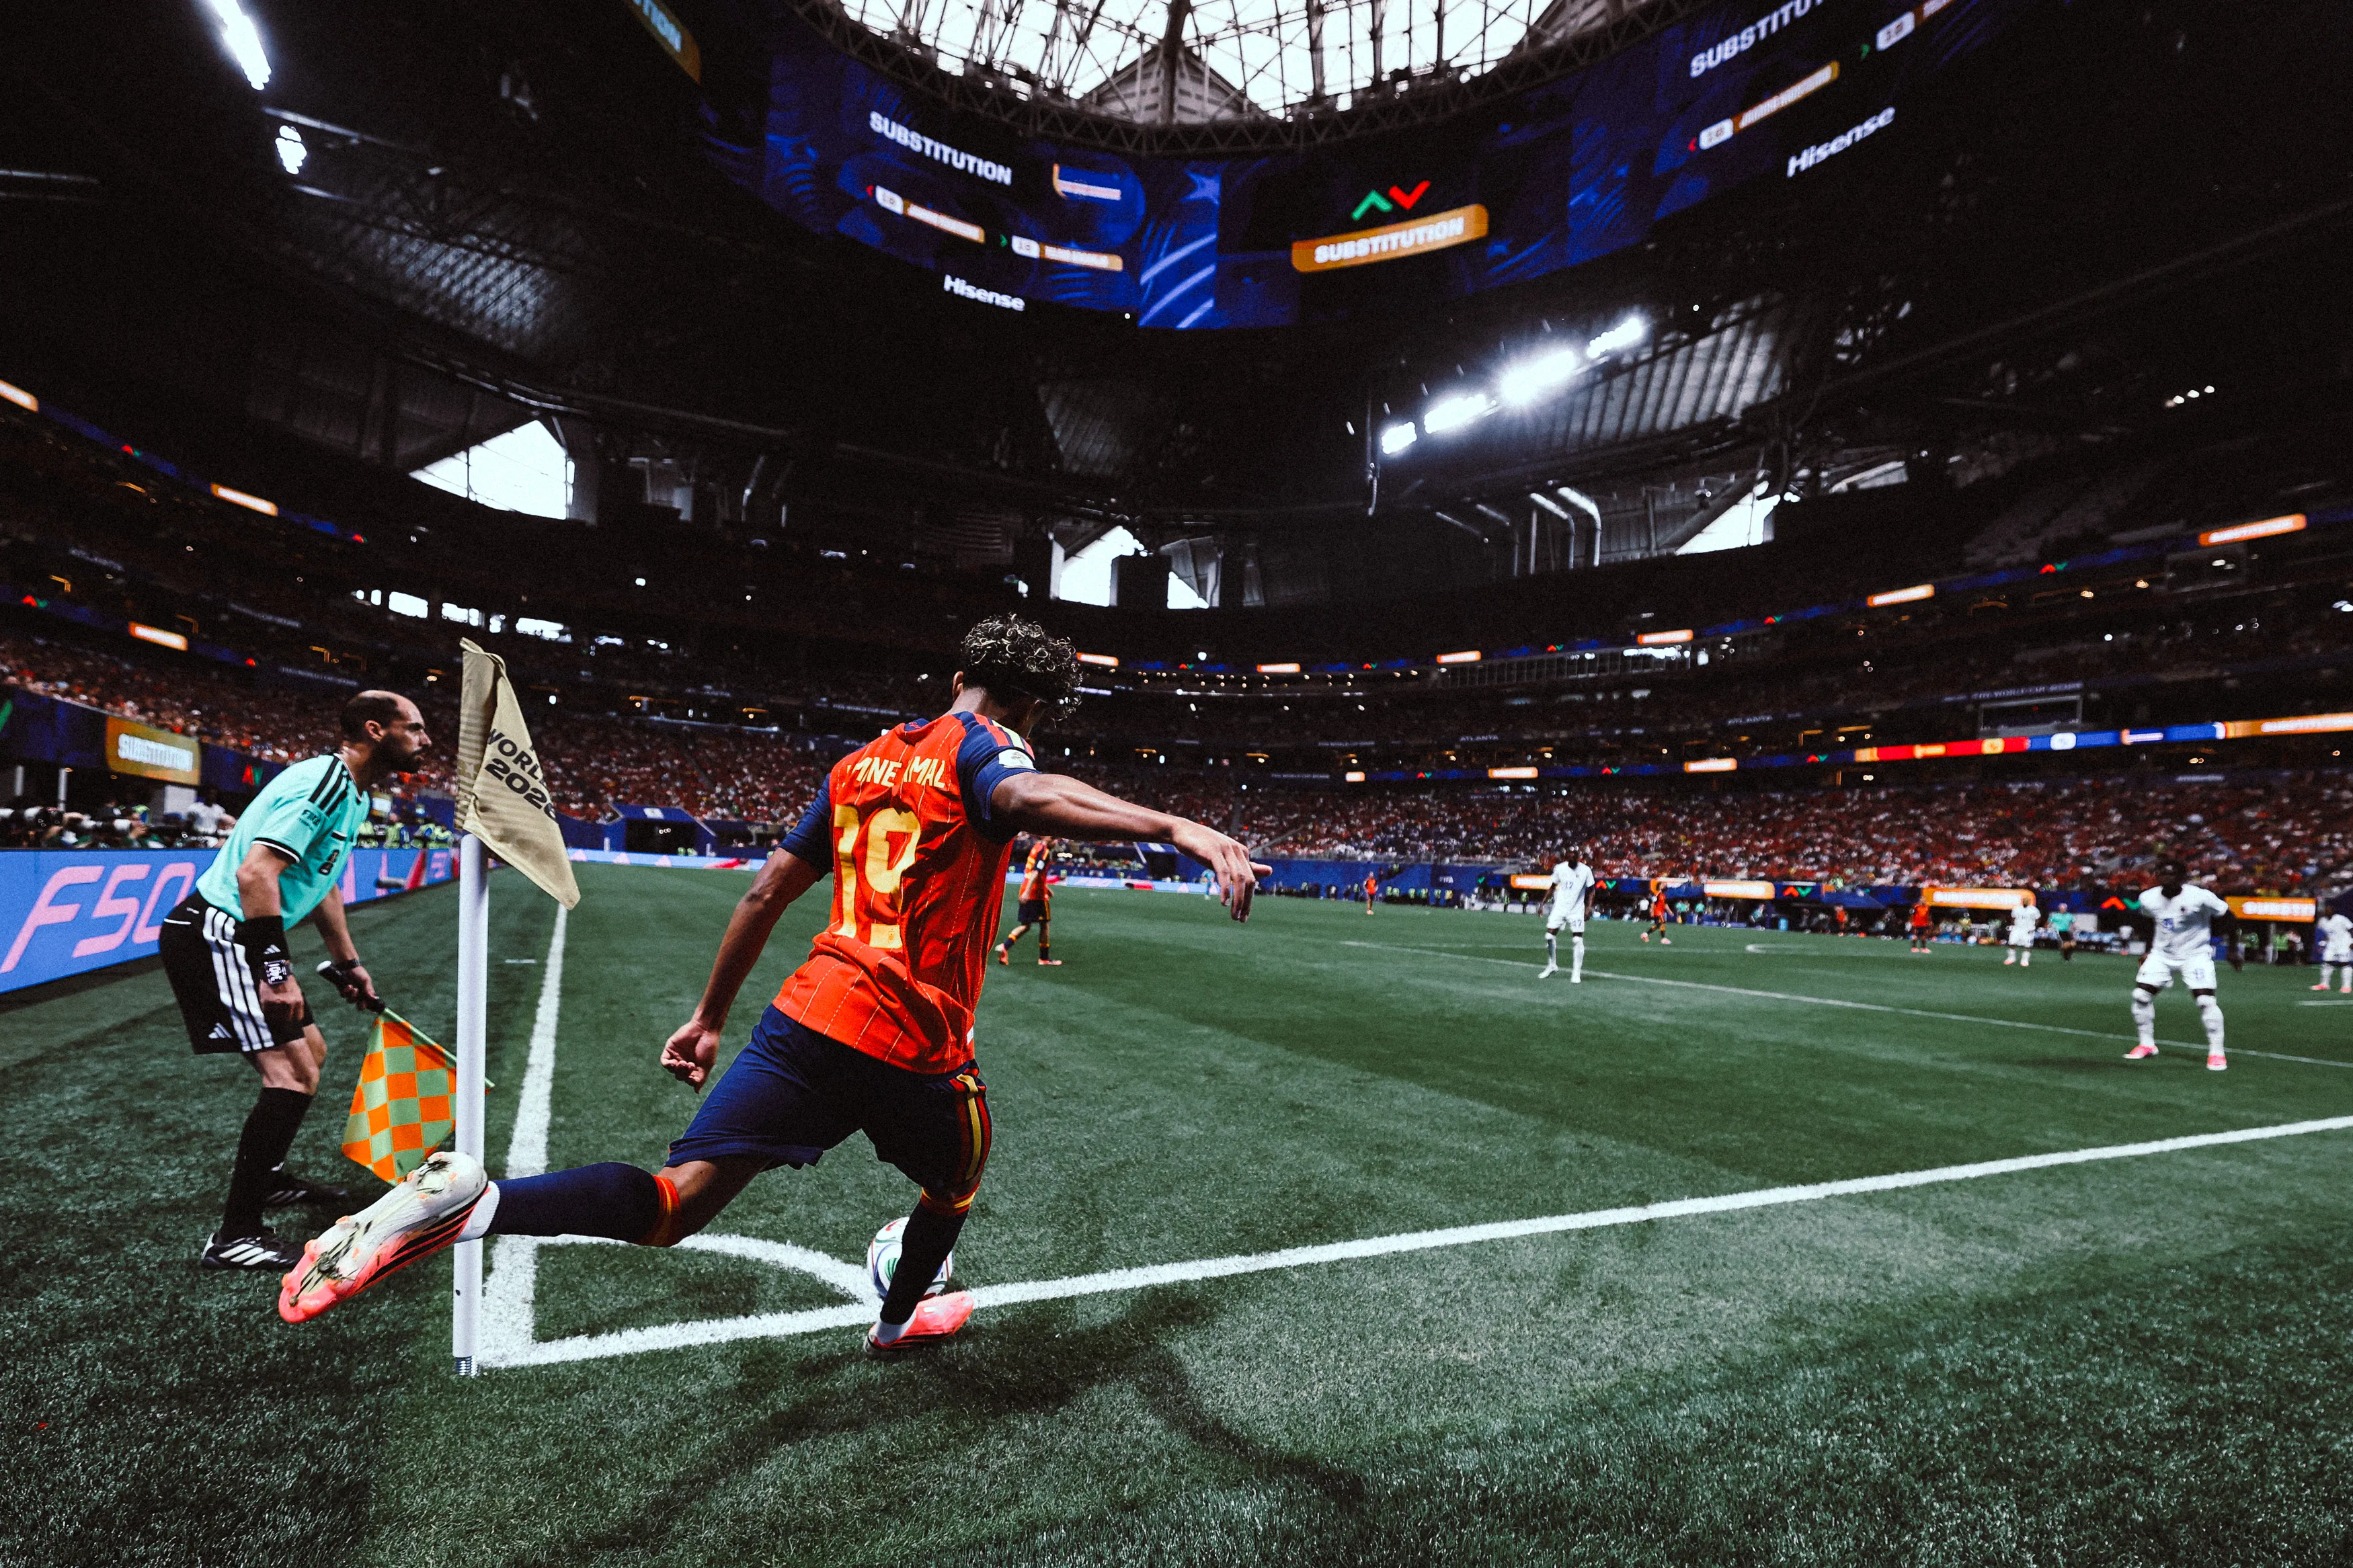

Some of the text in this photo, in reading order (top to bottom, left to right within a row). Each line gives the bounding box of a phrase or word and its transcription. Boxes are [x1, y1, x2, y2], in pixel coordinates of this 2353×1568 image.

[1689, 0, 1823, 78] SUBSTITU
[869, 111, 1012, 185] SUBSTITUTION
[1786, 107, 1895, 177] Hisense
[1314, 217, 1464, 263] SUBSTITUTION
[944, 274, 1025, 312] Hisense
[487, 729, 545, 786] WORL
